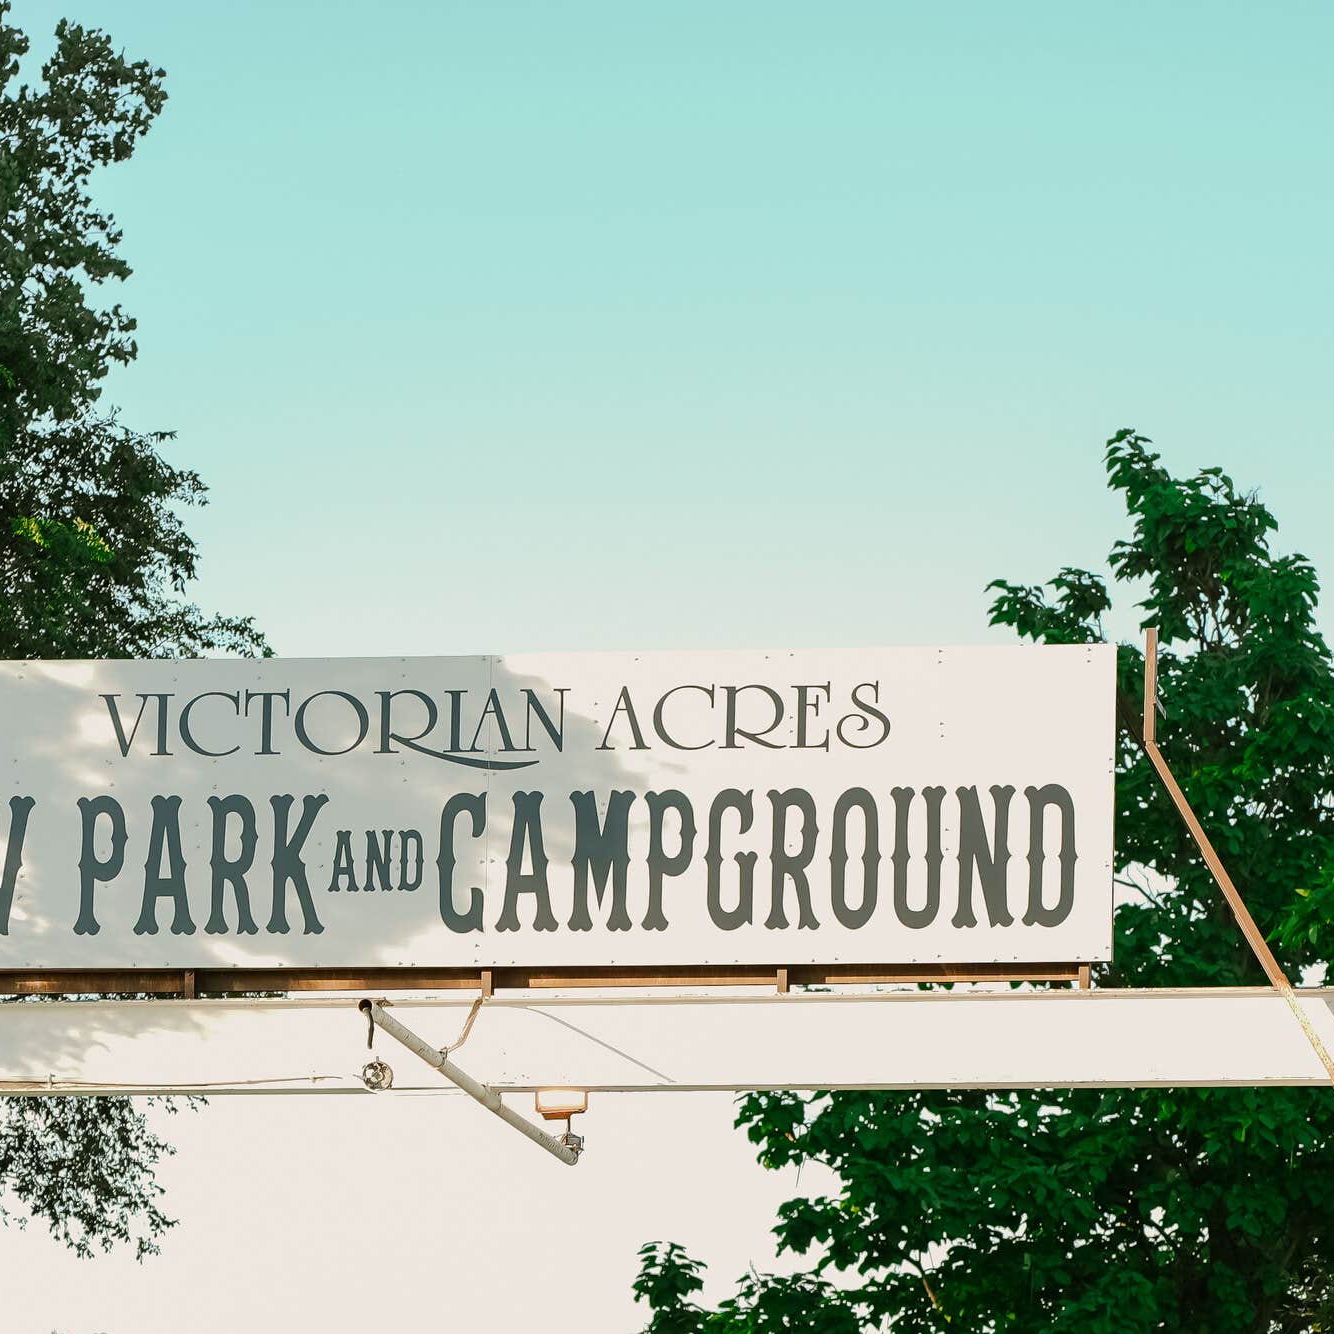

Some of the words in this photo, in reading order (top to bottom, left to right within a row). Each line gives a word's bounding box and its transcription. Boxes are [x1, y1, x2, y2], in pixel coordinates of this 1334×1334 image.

[97, 686, 573, 771] VICTORIAN
[595, 680, 892, 753] ACRES
[72, 792, 330, 937] PARK
[327, 829, 425, 894] AND
[435, 783, 1079, 935] CAMPGROUND
